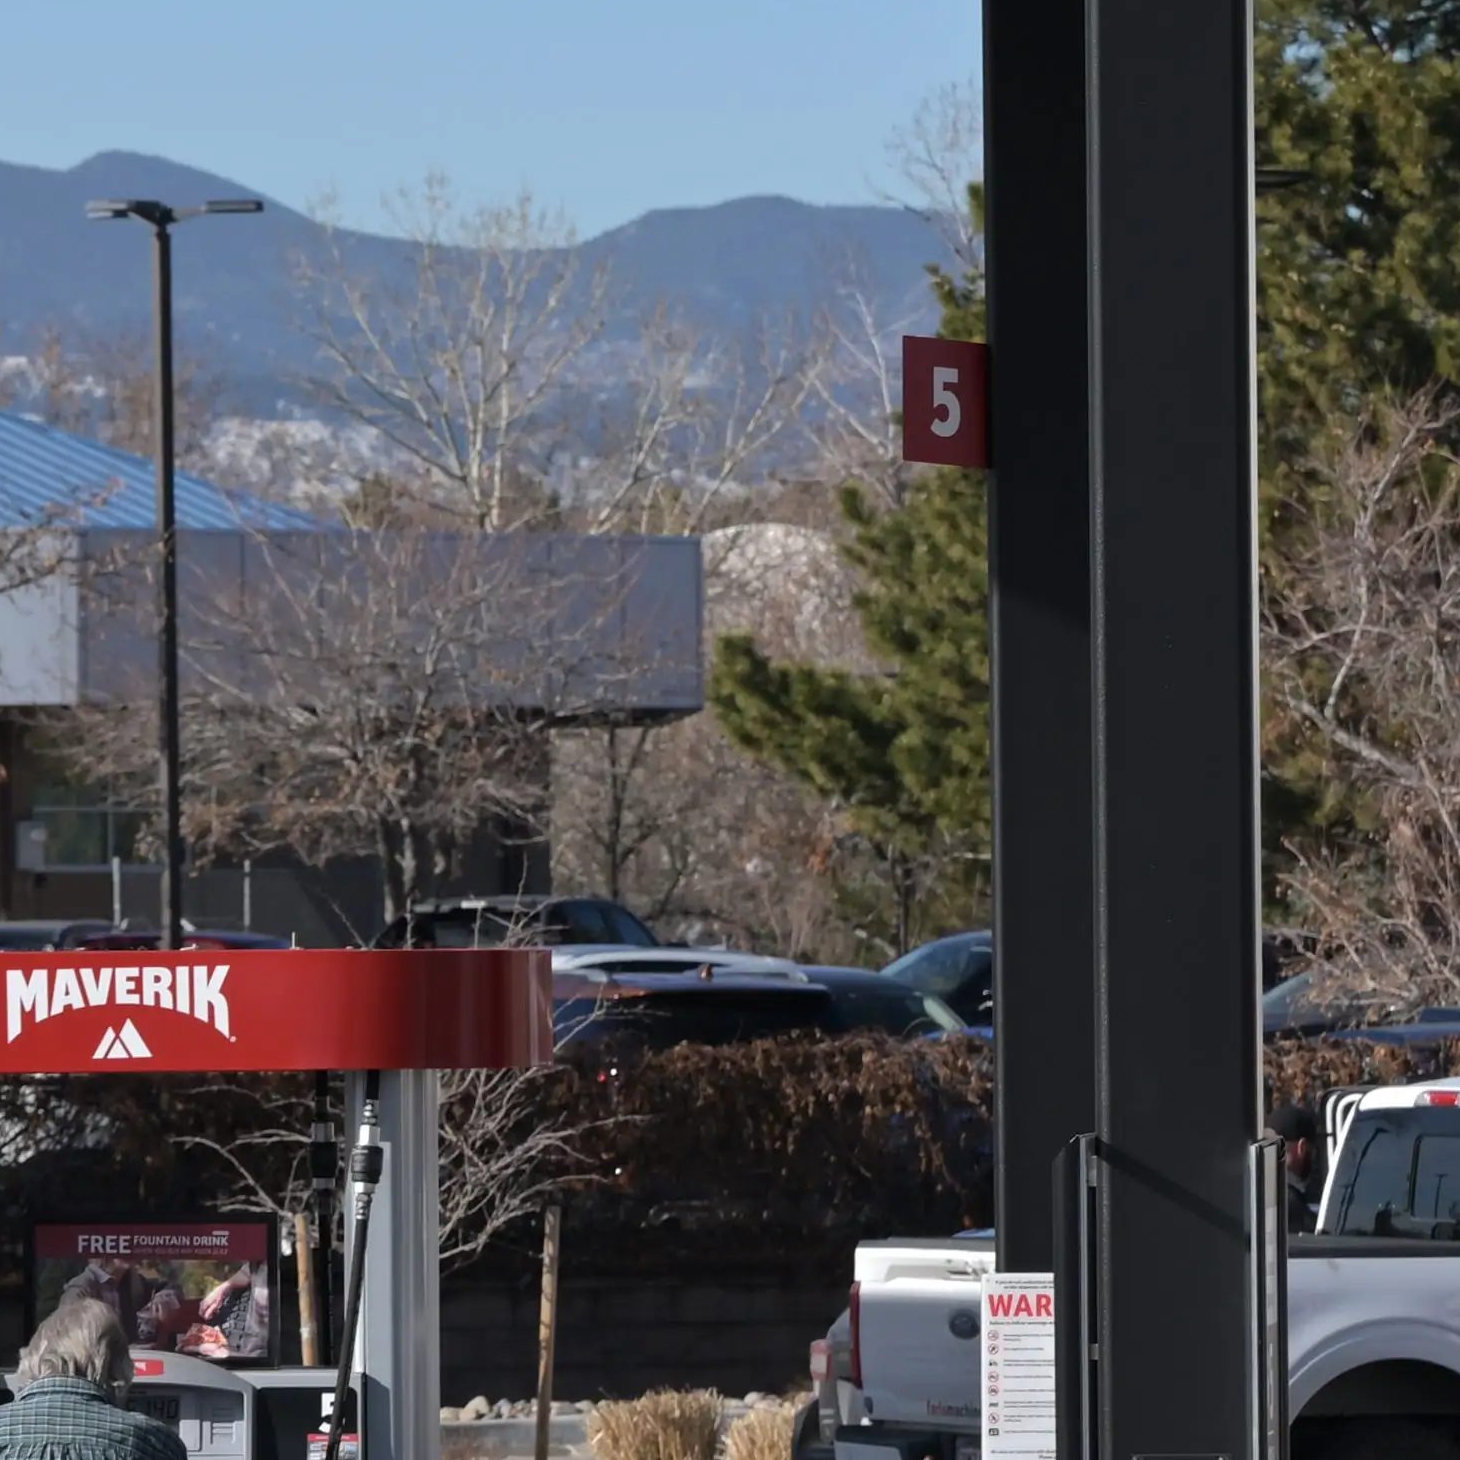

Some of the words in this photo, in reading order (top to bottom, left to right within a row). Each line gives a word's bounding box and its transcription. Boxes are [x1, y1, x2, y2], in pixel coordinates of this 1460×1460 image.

[930, 366, 961, 437] 5
[6, 964, 230, 1044] MAVERIK
[78, 1235, 131, 1254] FREE
[133, 1235, 190, 1246] FOUNTAIN
[193, 1235, 229, 1246] DRINK
[988, 1293, 1053, 1317] WAR
